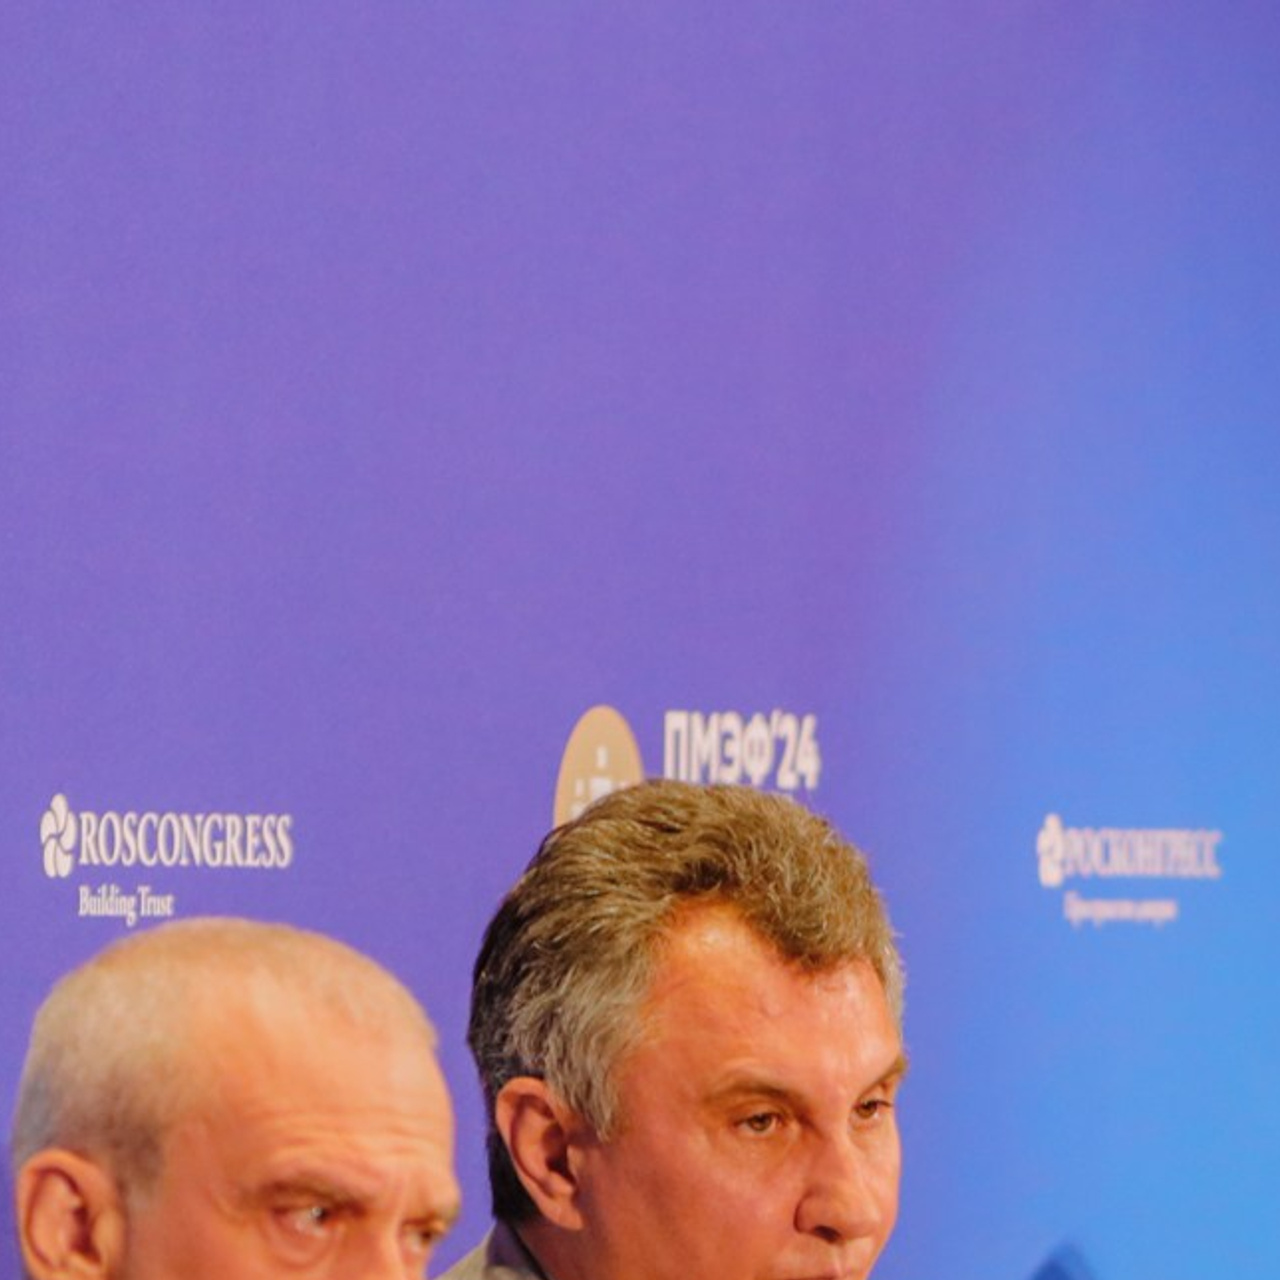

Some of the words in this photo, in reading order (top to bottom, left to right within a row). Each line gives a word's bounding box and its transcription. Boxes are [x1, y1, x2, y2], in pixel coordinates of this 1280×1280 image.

[663, 708, 822, 790] ПМЭФ'24
[78, 811, 294, 869] ROSCONGRESS
[78, 884, 138, 928] Building
[137, 885, 175, 917] Trust
